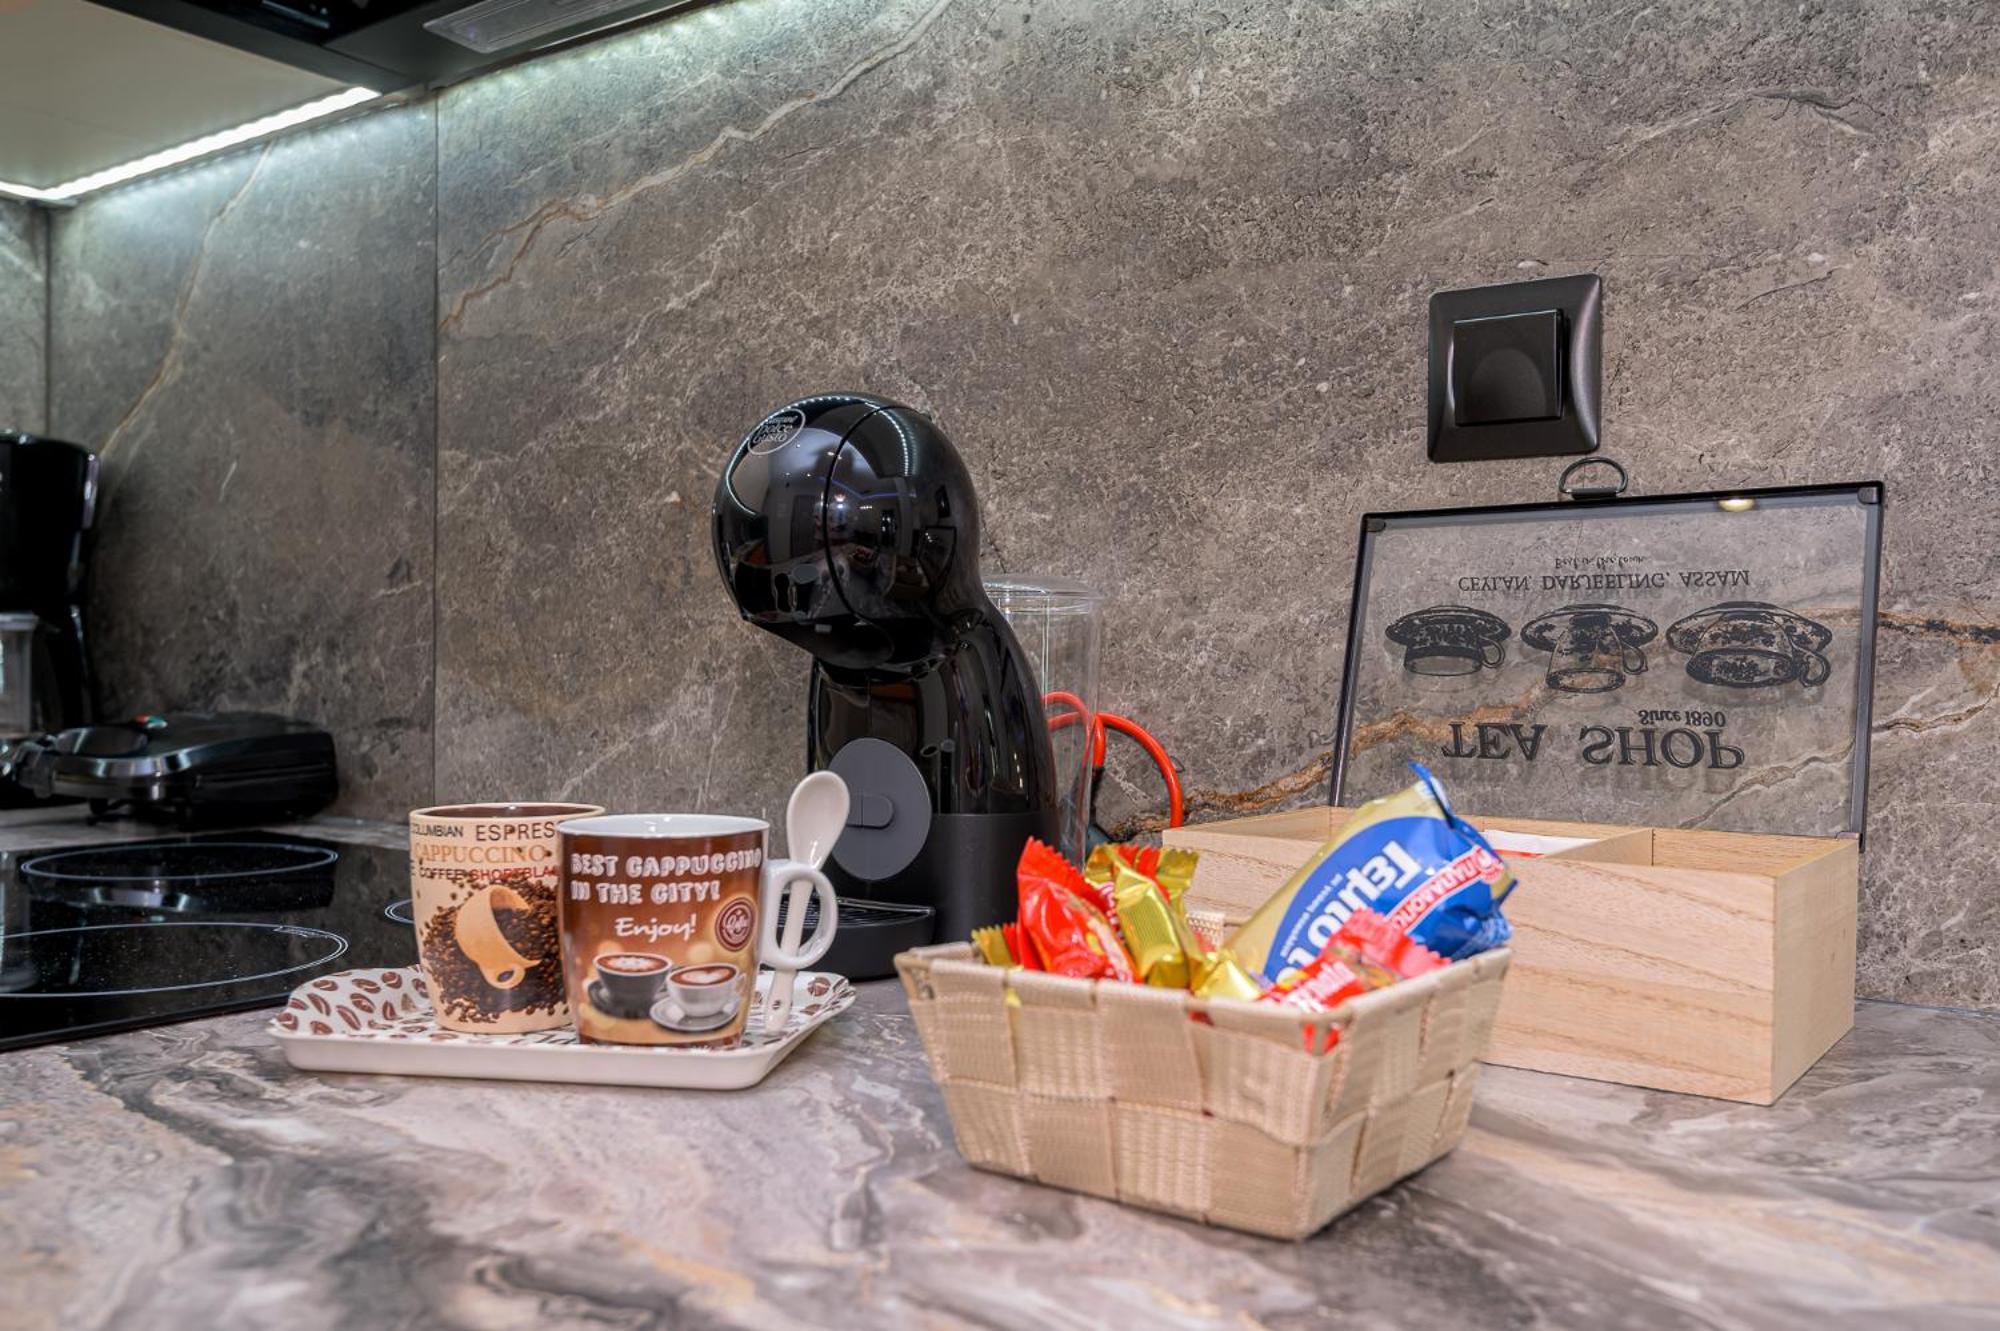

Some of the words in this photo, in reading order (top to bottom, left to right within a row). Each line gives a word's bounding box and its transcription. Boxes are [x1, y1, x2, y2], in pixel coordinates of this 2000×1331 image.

[476, 821, 562, 841] ESPRES
[415, 841, 547, 864] CAPPUCCINO
[571, 853, 619, 877] BEST
[626, 848, 762, 878] CAPPUCCINO
[420, 866, 465, 880] COFFEE
[571, 880, 591, 901] IN
[596, 882, 643, 905] THE
[651, 879, 721, 904] CITY!
[615, 913, 698, 943] Enjoy!
